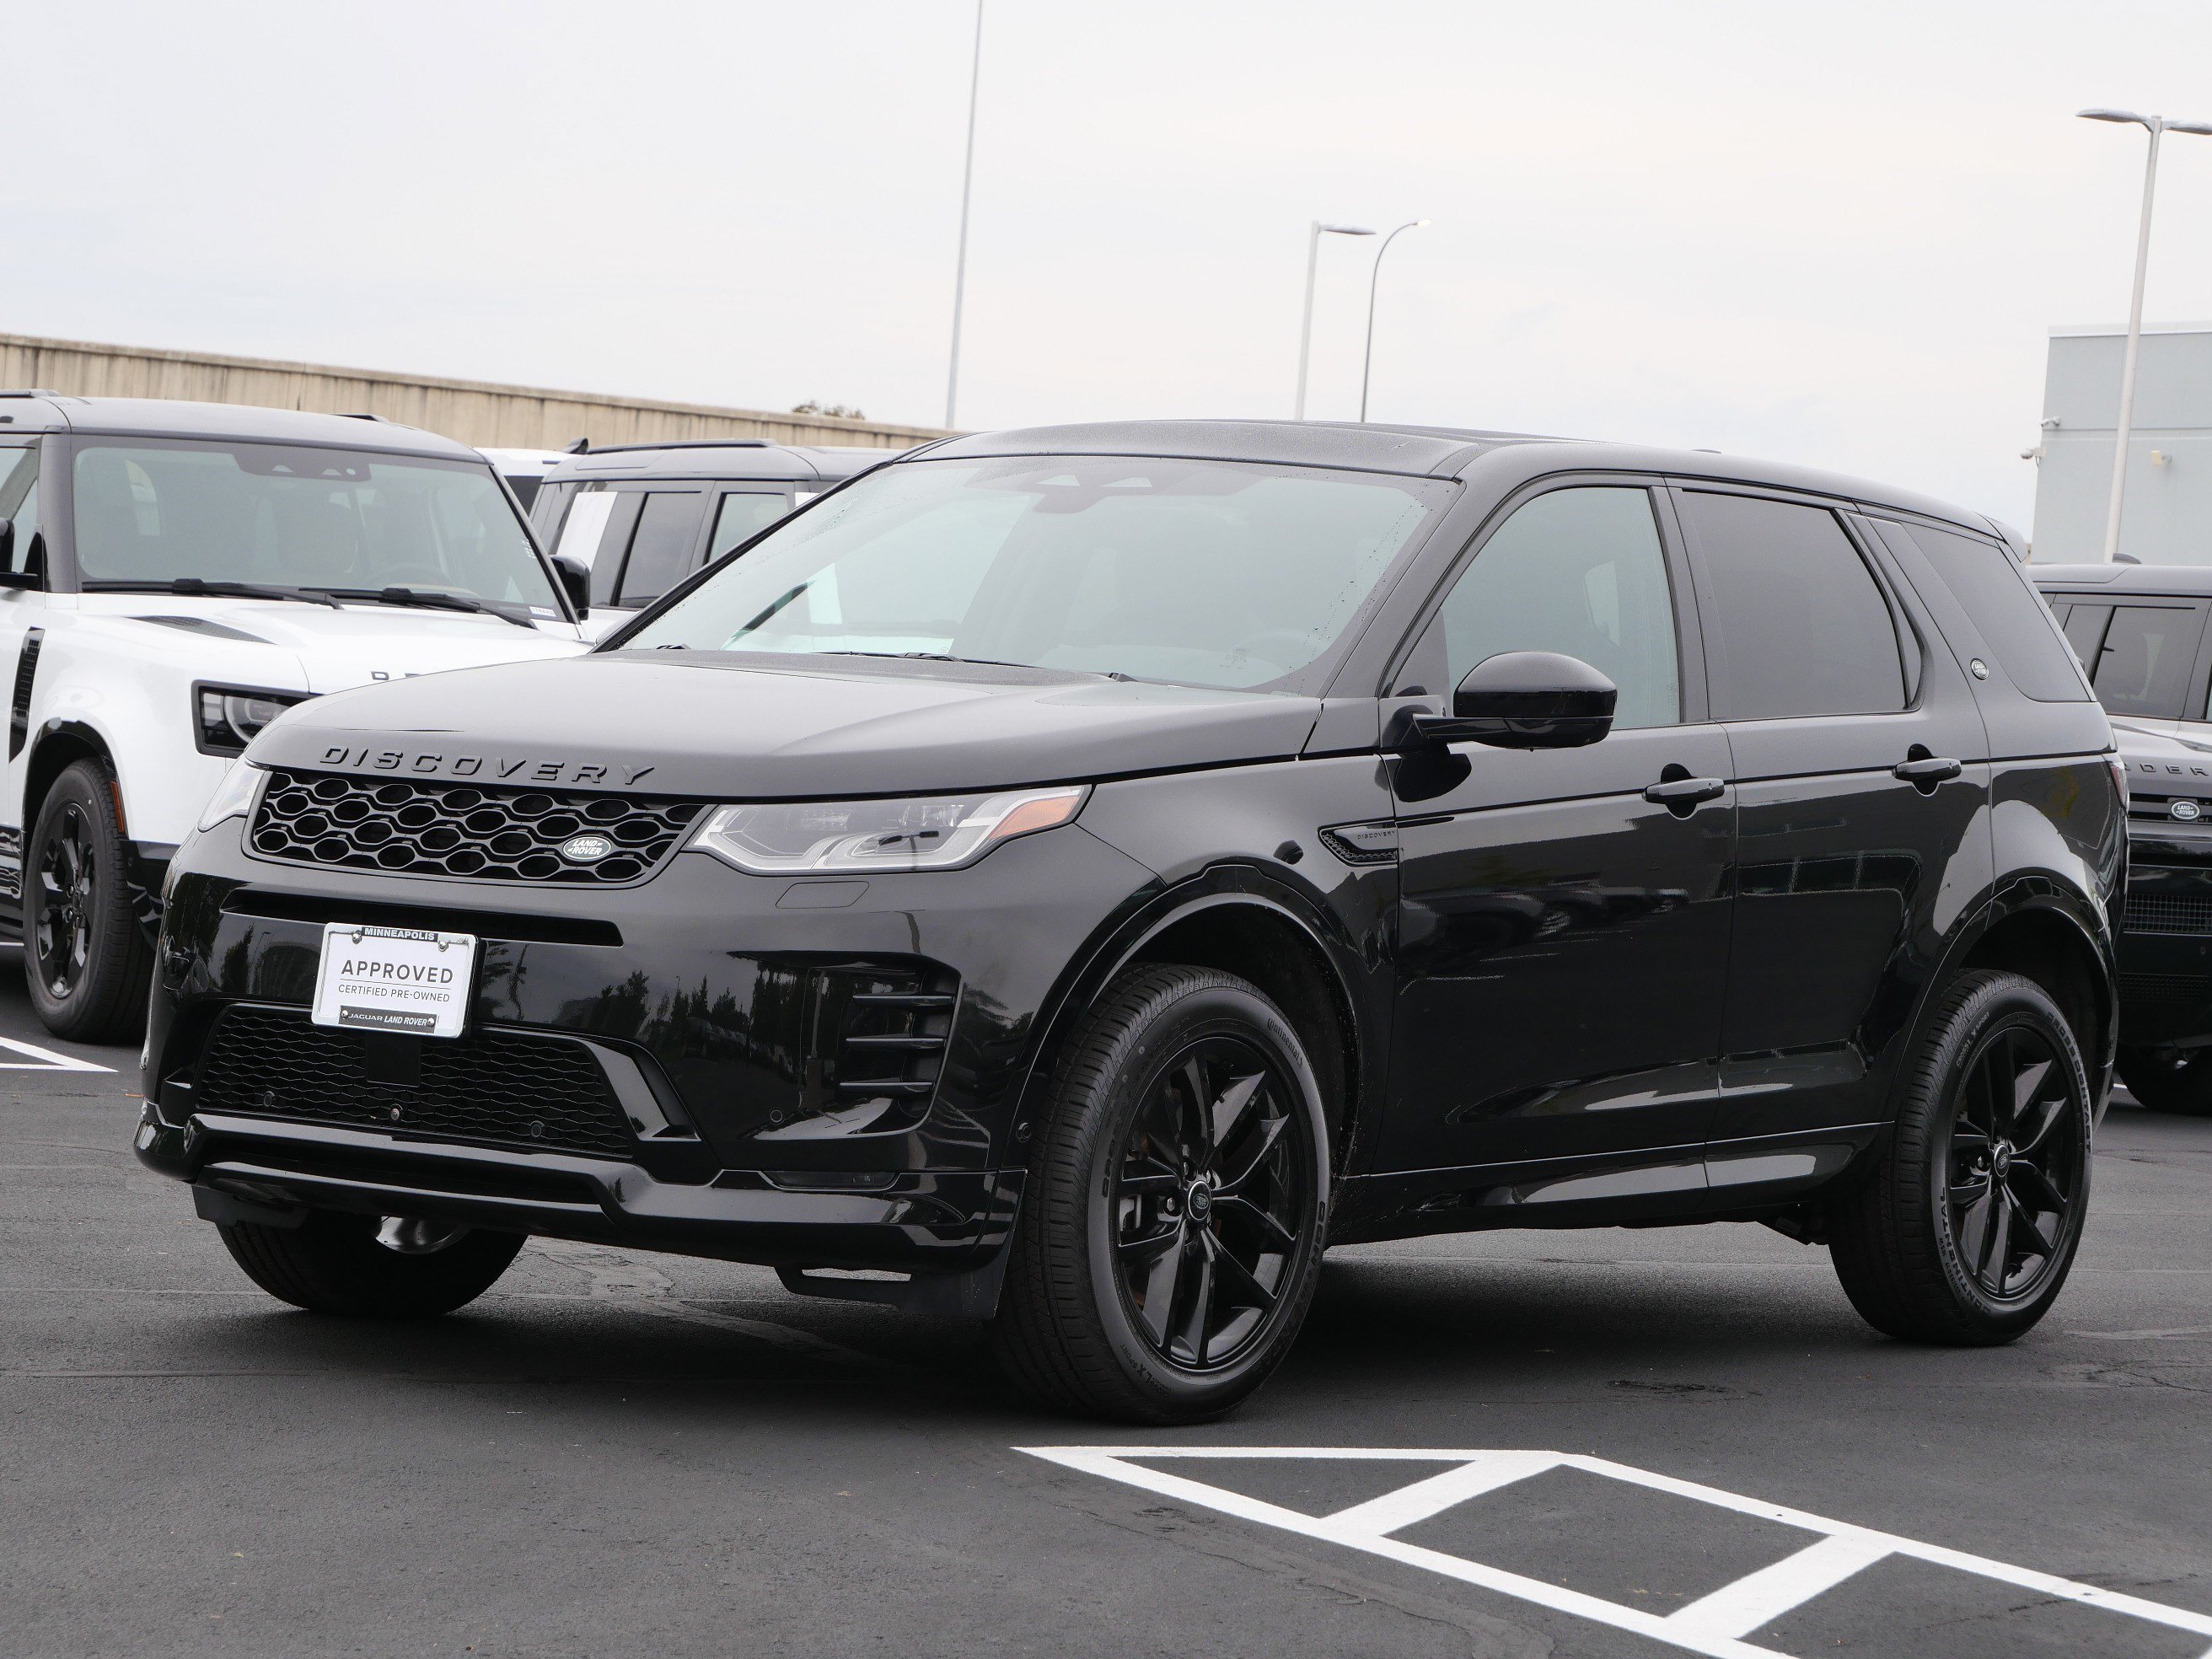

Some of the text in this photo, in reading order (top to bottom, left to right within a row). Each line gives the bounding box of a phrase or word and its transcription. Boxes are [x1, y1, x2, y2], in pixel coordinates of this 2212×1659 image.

[319, 744, 654, 786] DISCOVERY
[1357, 830, 1396, 840] DISCOVERY
[571, 846, 603, 855] ROVER
[364, 927, 435, 941] MINNEAPOLIS
[341, 959, 454, 984] APPROVED
[338, 984, 450, 1002] CERTIFIED PRE-OWNED
[347, 1012, 427, 1027] JAGUAR LAND ROVER
[1267, 1017, 1300, 1061] Continental
[1119, 1345, 1138, 1368] SPORT
